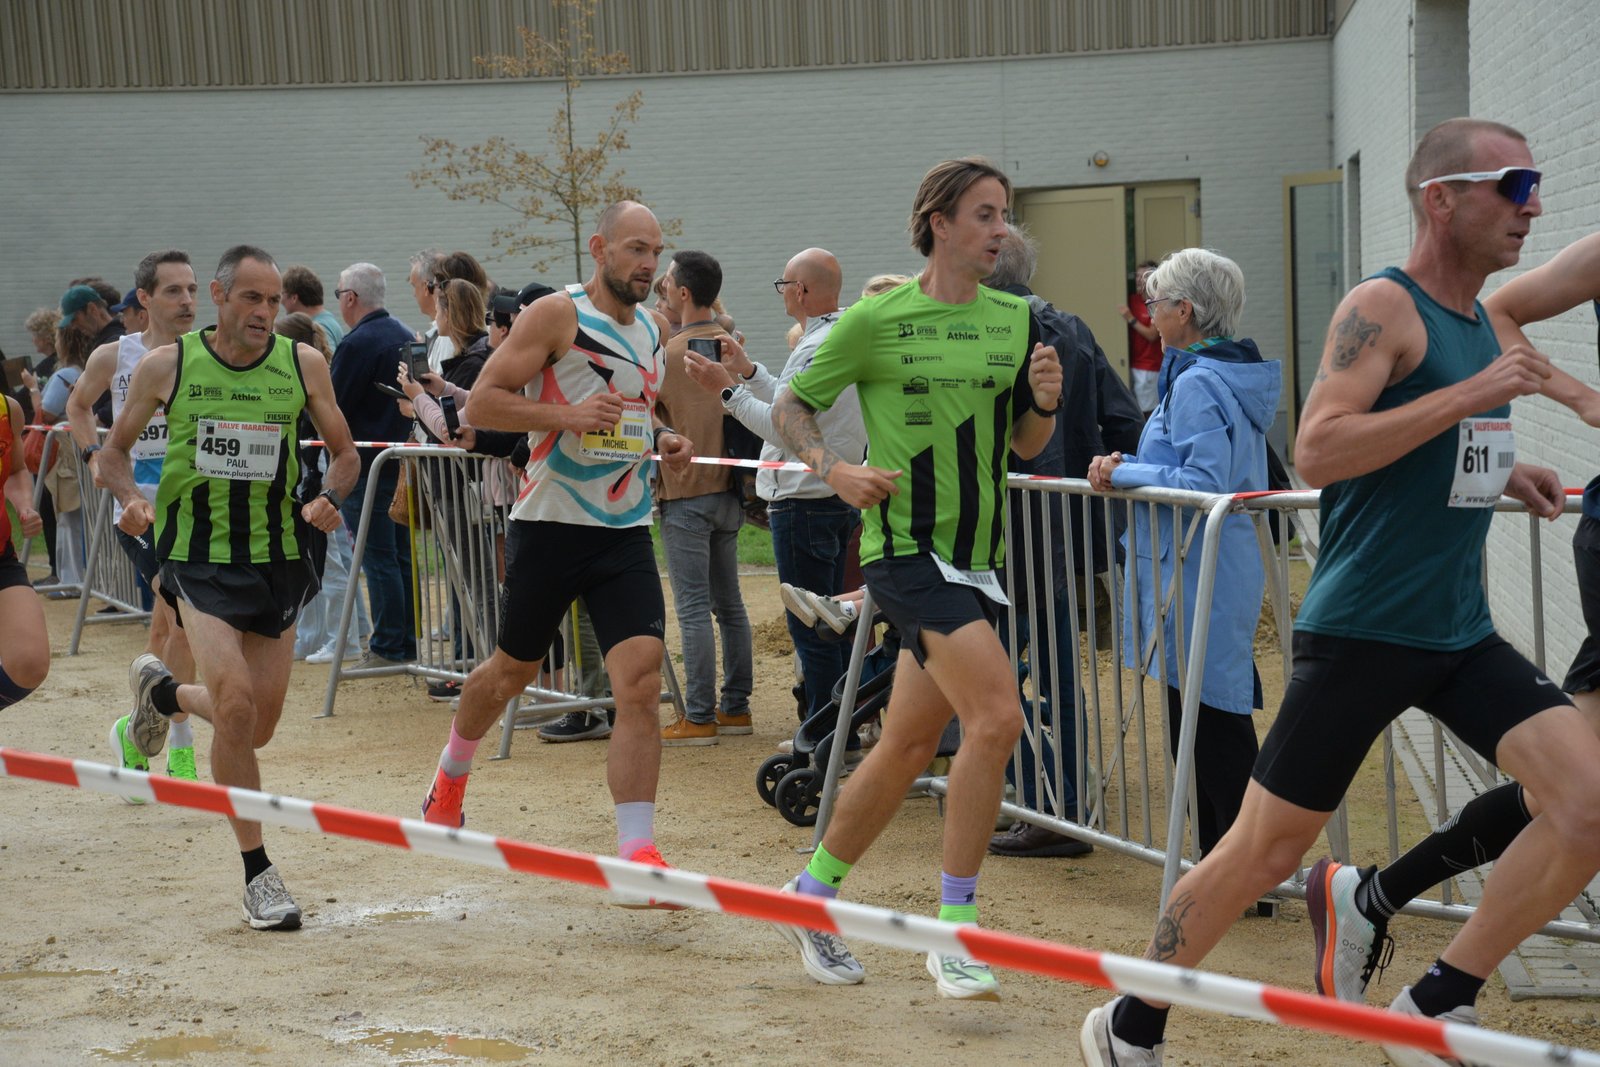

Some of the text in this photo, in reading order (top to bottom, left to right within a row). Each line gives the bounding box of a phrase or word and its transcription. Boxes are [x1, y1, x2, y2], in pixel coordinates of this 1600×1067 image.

[947, 331, 980, 341] Athlex
[264, 364, 292, 380] BIORACER
[230, 393, 262, 401] Athlex
[217, 422, 240, 430] HALVE
[241, 423, 280, 433] MARATHON
[200, 437, 241, 457] 459
[602, 438, 629, 450] MICHIEL
[594, 449, 641, 460] www.plusprint.be
[1463, 445, 1489, 474] 611
[226, 458, 249, 469] PAUL
[210, 468, 275, 479] www.plusprint.be
